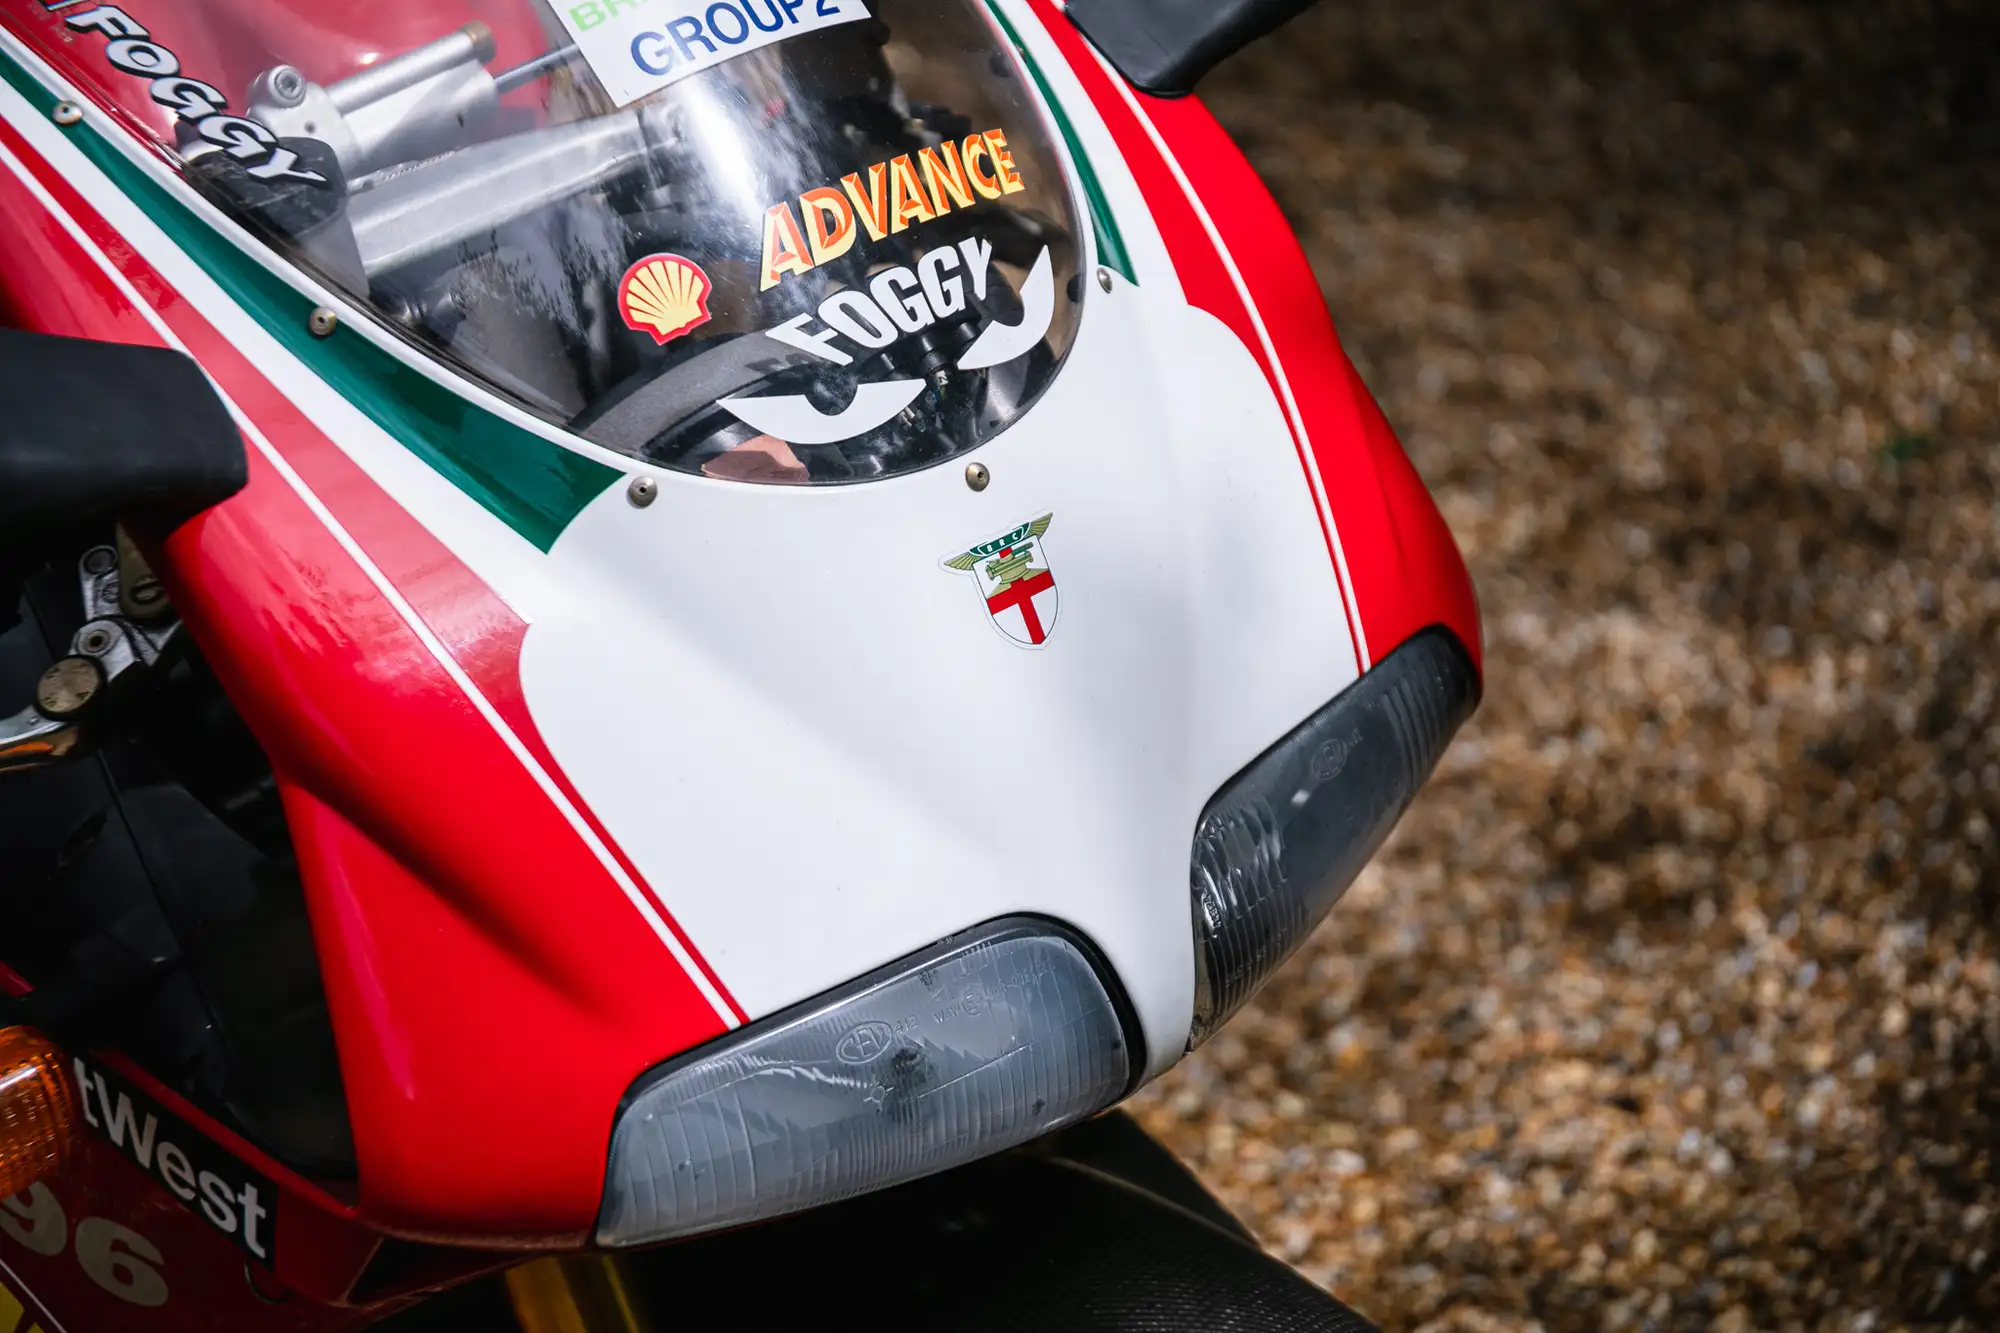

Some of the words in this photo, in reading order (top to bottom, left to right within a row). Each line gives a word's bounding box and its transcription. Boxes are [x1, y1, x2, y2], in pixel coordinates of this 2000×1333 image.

[64, 5, 332, 187] FOGGY
[760, 128, 1025, 292] ADVANCE
[765, 236, 992, 366] FOGGY
